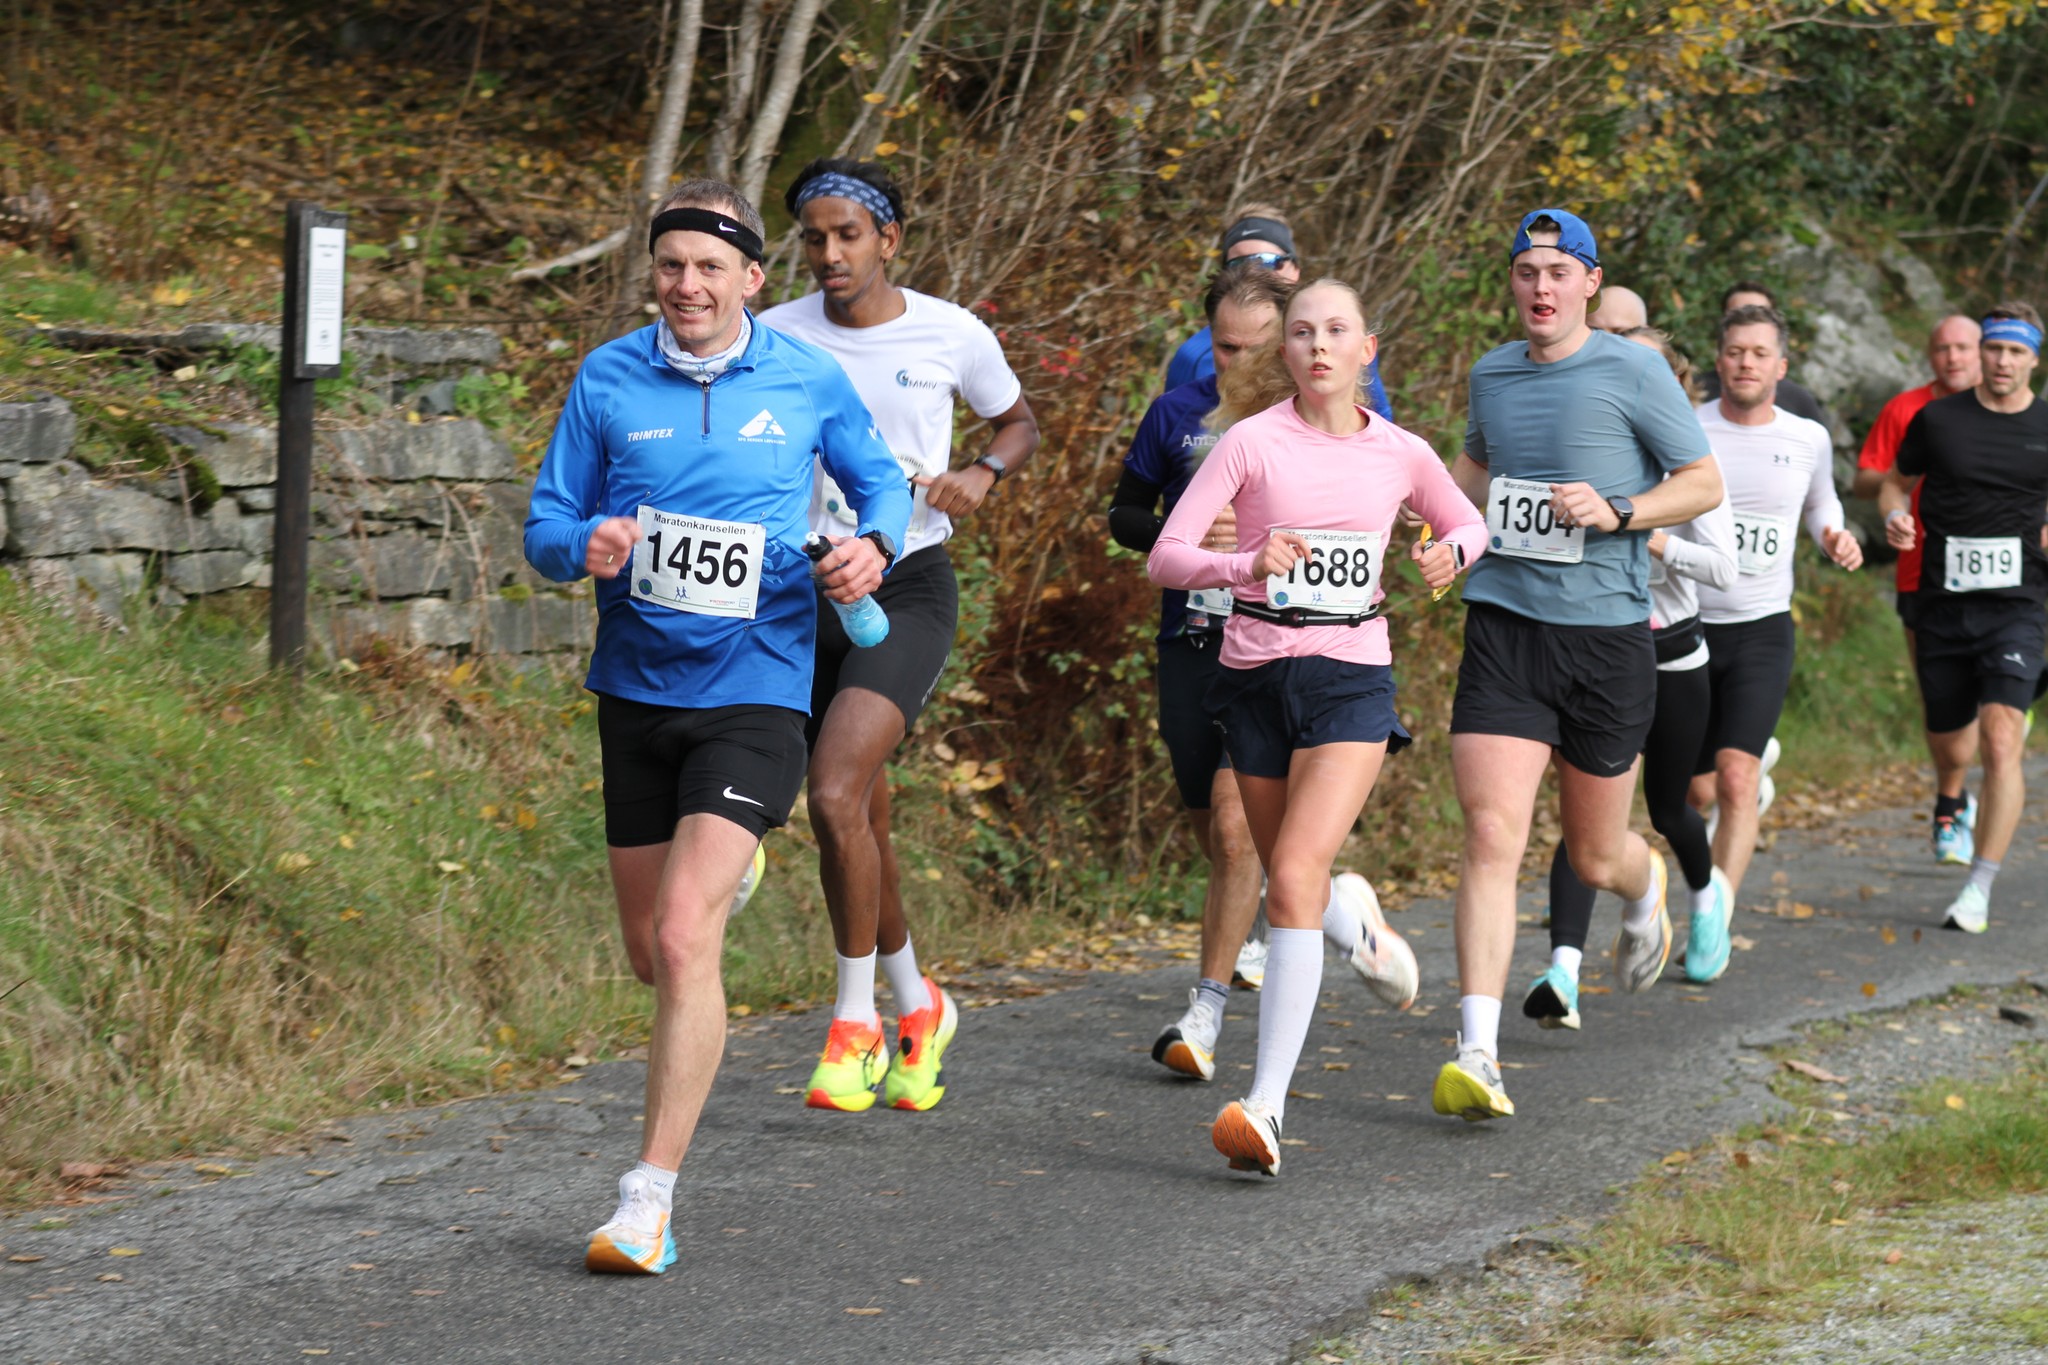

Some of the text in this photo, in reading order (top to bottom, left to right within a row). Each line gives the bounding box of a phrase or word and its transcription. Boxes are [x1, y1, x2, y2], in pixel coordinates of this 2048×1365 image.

[627, 428, 674, 442] TRIMTEX
[653, 512, 747, 535] Maratonkarusellen
[1288, 531, 1368, 542] ratonkarusellen
[647, 530, 749, 588] 1456
[1955, 549, 2012, 575] 1819
